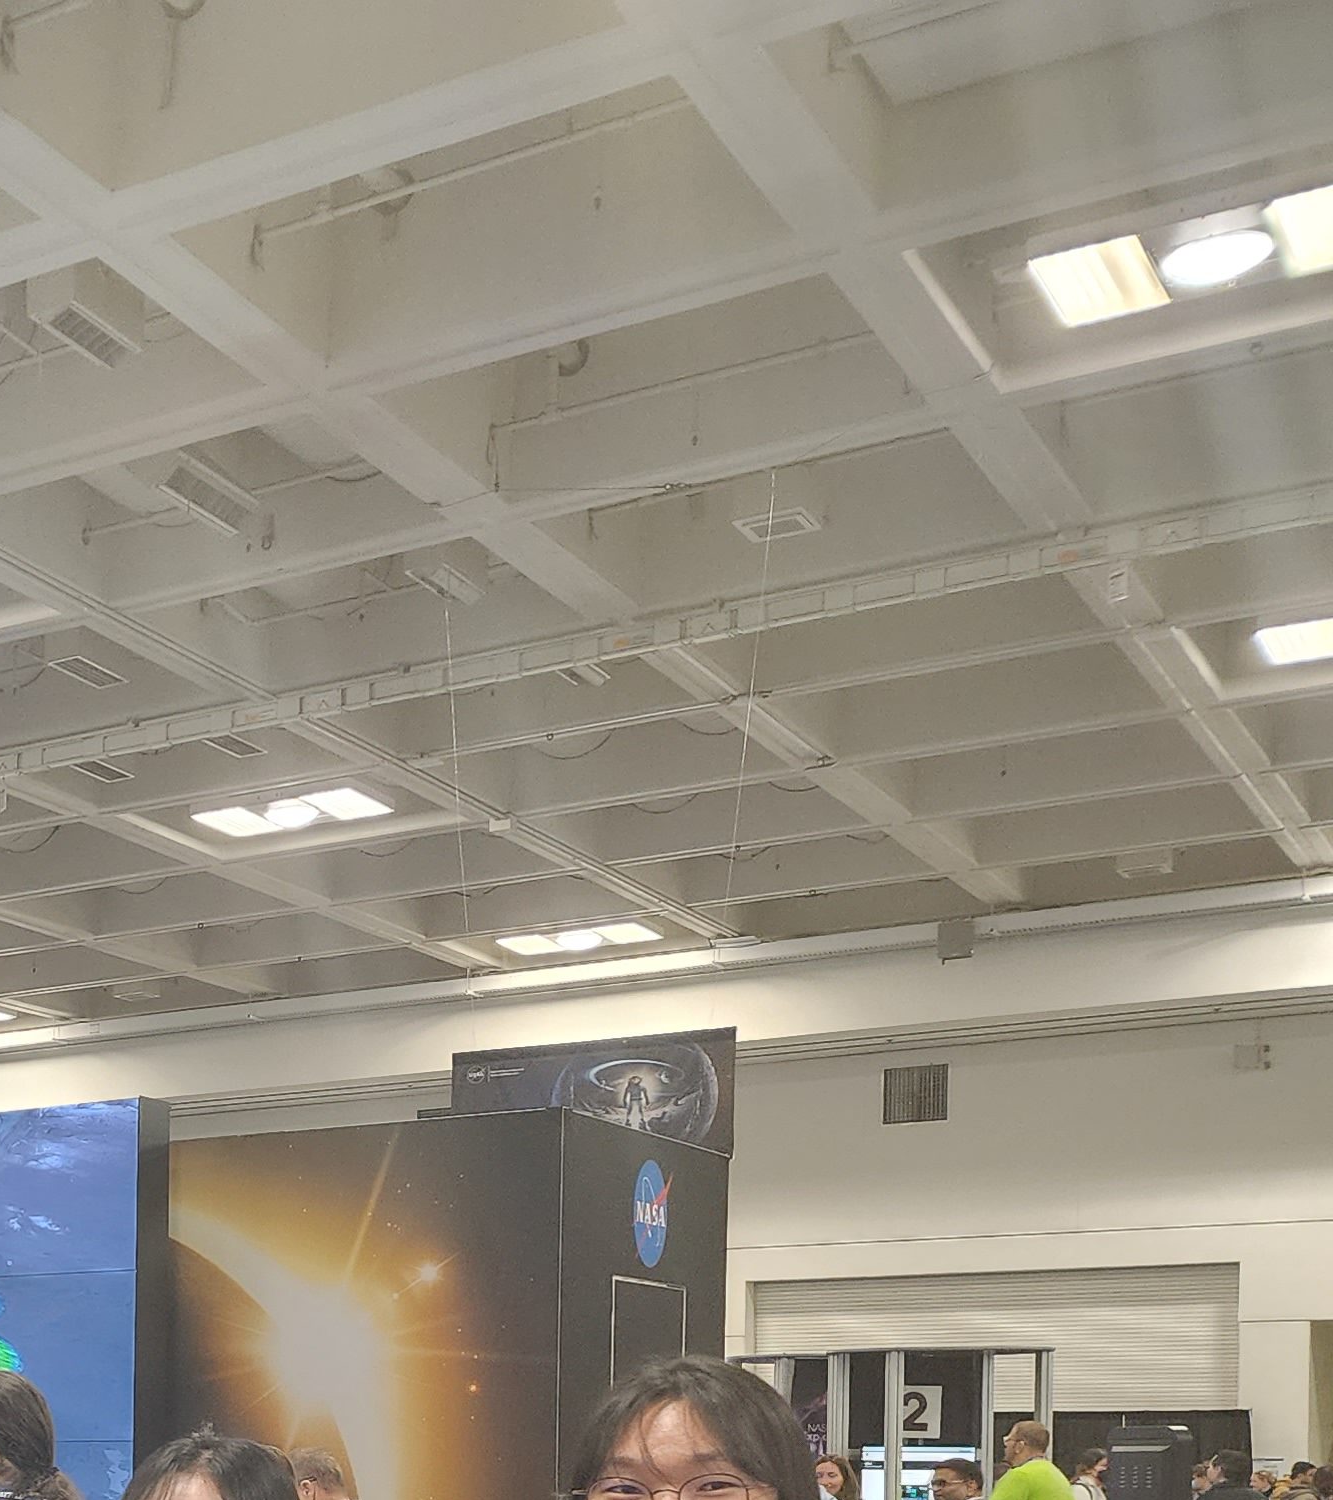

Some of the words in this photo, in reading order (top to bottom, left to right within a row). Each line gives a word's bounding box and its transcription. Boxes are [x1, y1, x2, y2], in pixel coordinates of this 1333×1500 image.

[636, 1200, 667, 1228] NASA
[903, 1392, 928, 1431] 2
[807, 1423, 827, 1433] NAS
